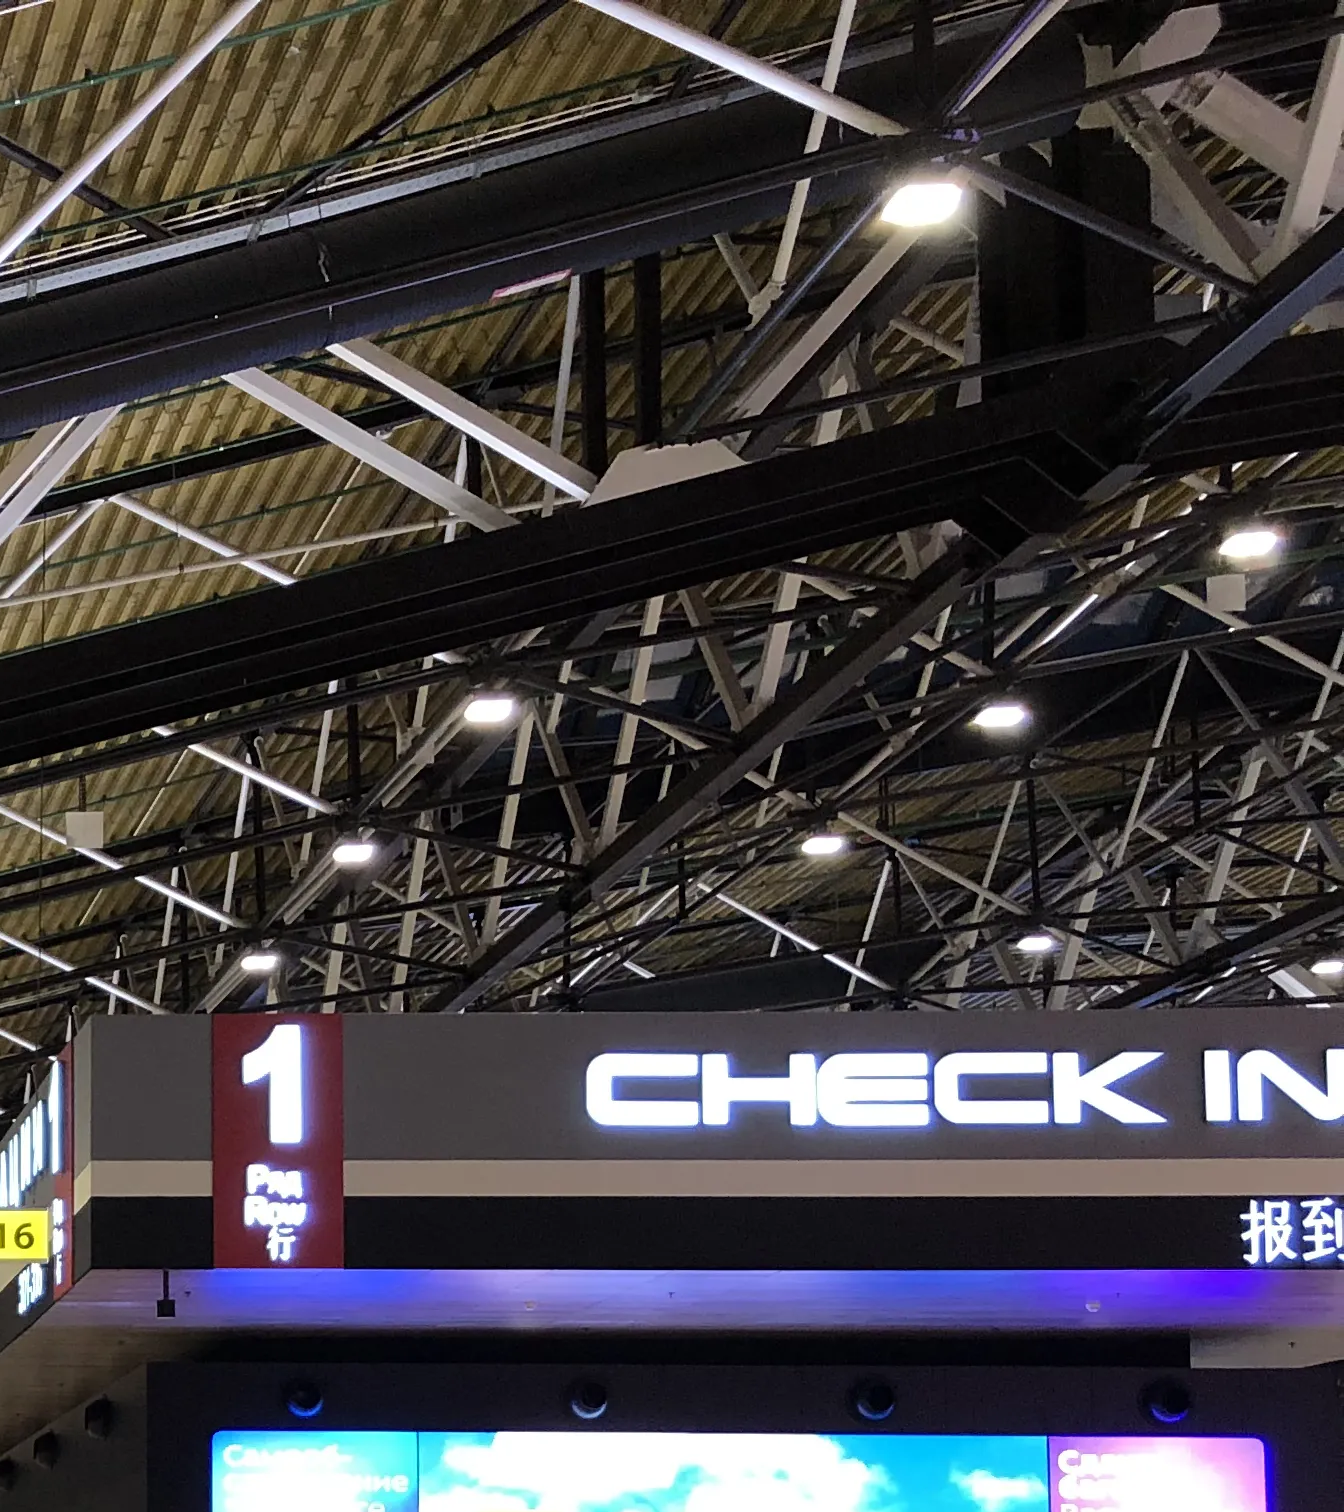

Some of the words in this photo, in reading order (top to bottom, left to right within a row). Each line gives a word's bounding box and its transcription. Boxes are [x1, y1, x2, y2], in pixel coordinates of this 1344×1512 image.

[242, 1024, 302, 1144] 1
[586, 1052, 1169, 1127] CHECK
[1204, 1049, 1344, 1122] IN
[243, 1195, 307, 1227] Row
[267, 1225, 296, 1262] 行
[1240, 1197, 1344, 1267] 报到
